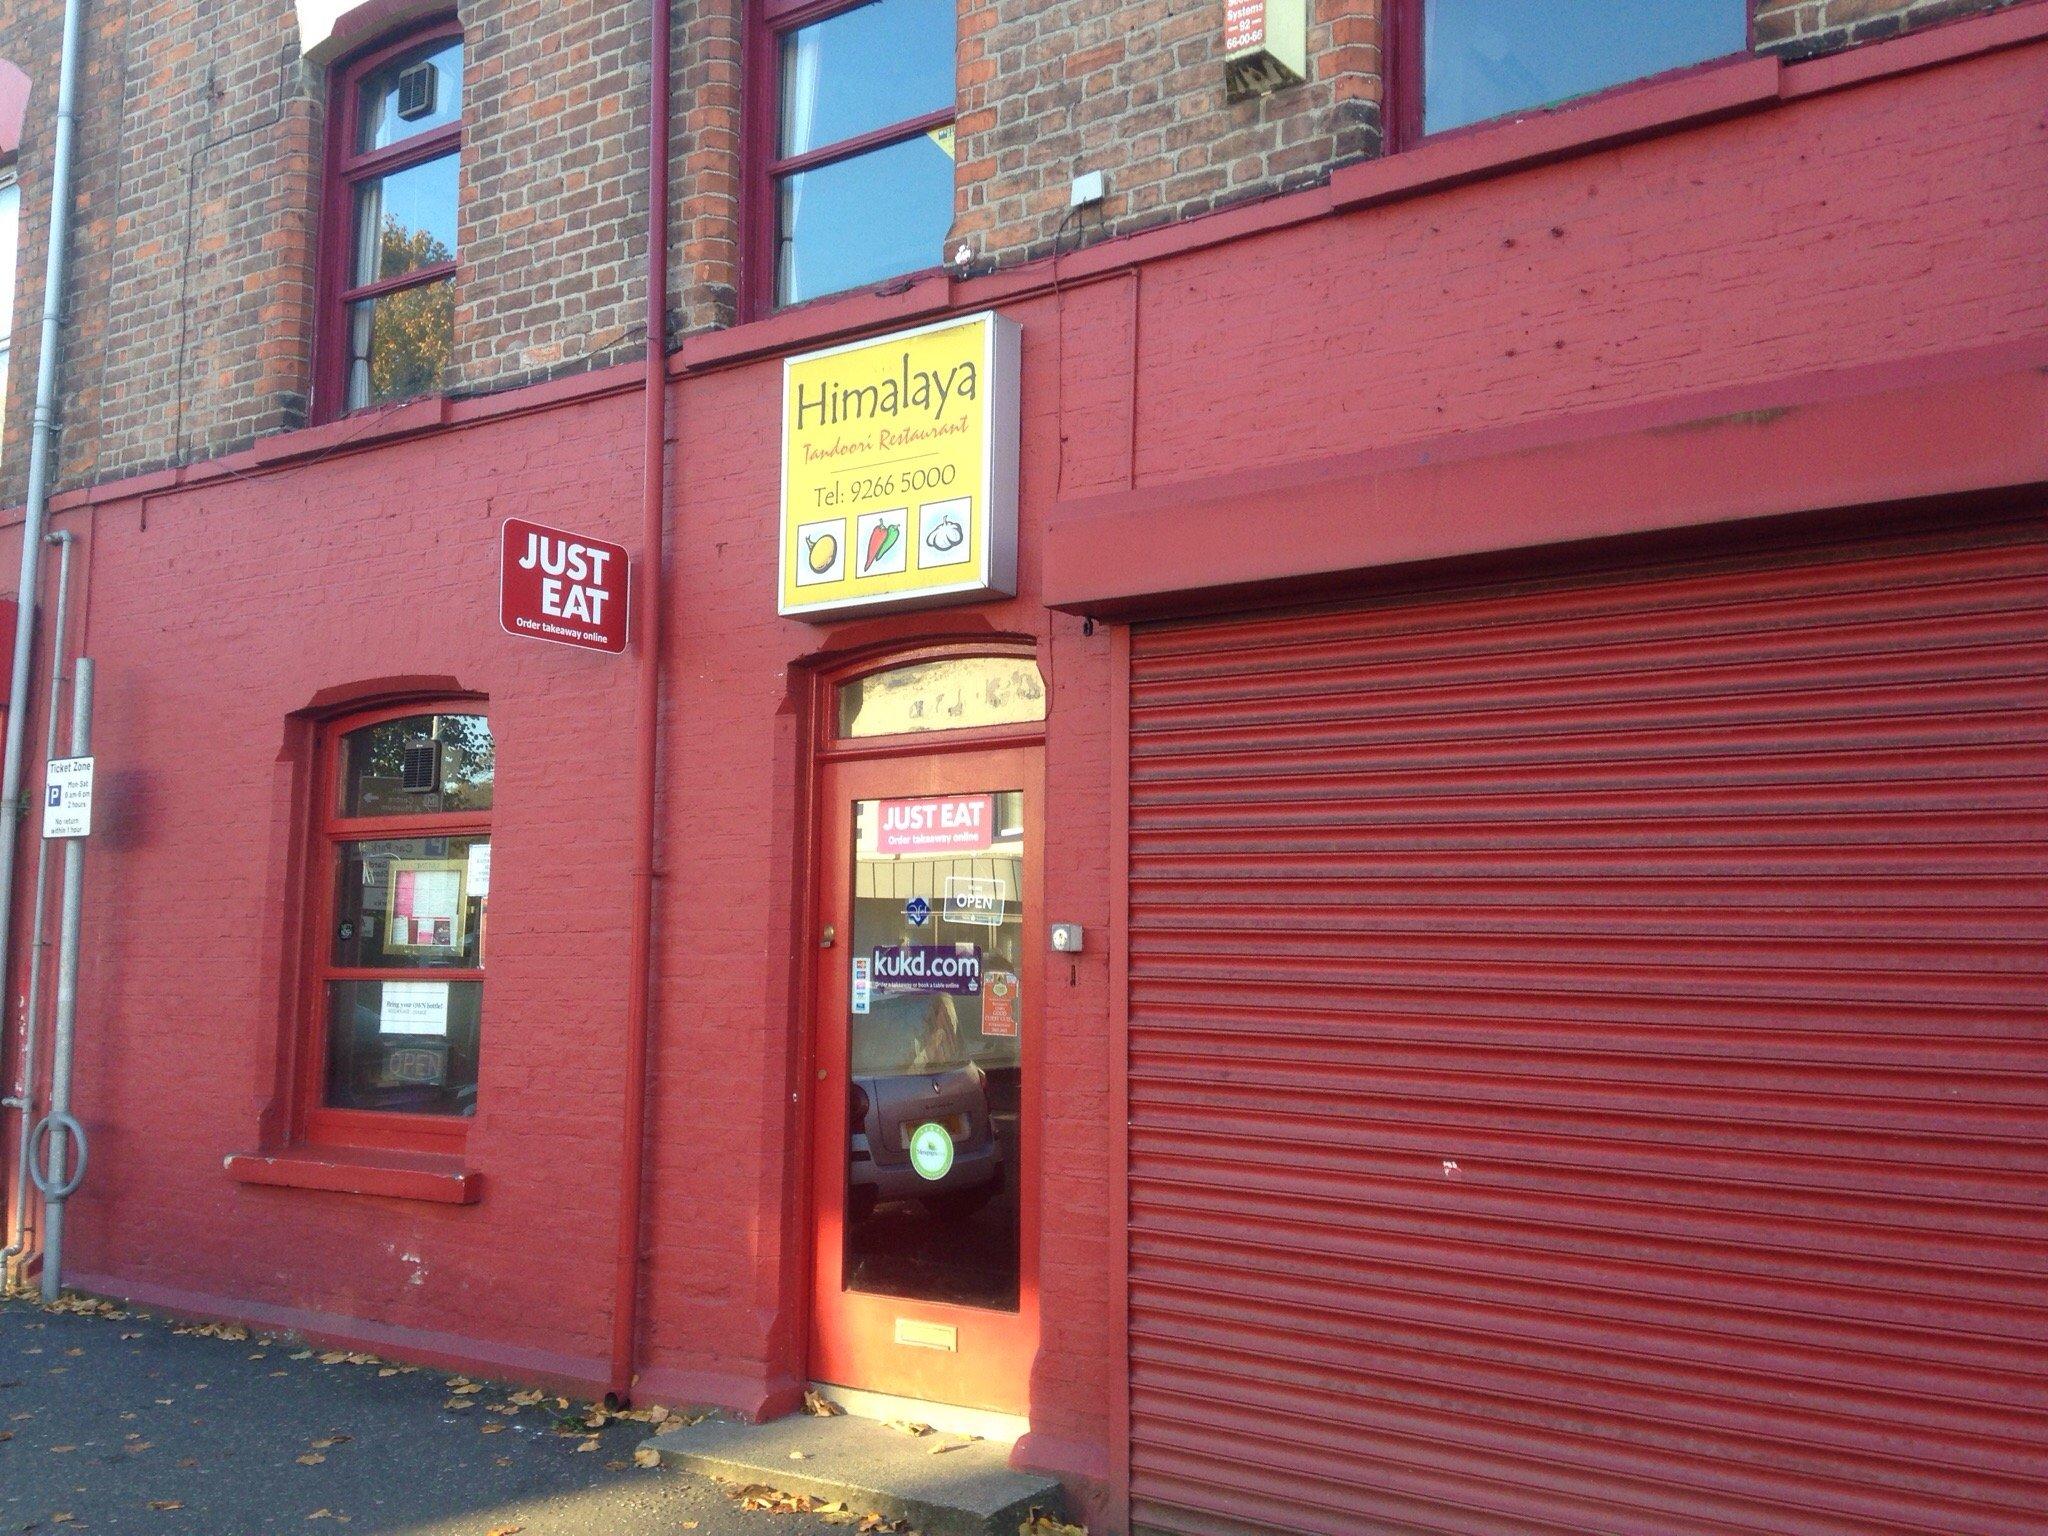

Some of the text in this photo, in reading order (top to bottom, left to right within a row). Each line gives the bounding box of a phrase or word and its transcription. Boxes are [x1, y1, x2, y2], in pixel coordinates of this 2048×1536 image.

[1227, 3, 1263, 21] Systems
[797, 353, 976, 429] Himalaya
[803, 415, 968, 464] Tandoori Restaurant
[814, 464, 956, 507] Tel: 9266 5000
[519, 532, 610, 585] JUST
[541, 577, 609, 625] EAT
[516, 617, 608, 643] Order takeaway online
[50, 761, 91, 773] Ticket Zone
[50, 788, 59, 804] P
[883, 802, 984, 831] JUST EAT
[888, 832, 979, 845] Order takeaway online
[957, 893, 993, 909] OPEN
[875, 950, 979, 977] kukd.com
[389, 1051, 440, 1076] OPEN
